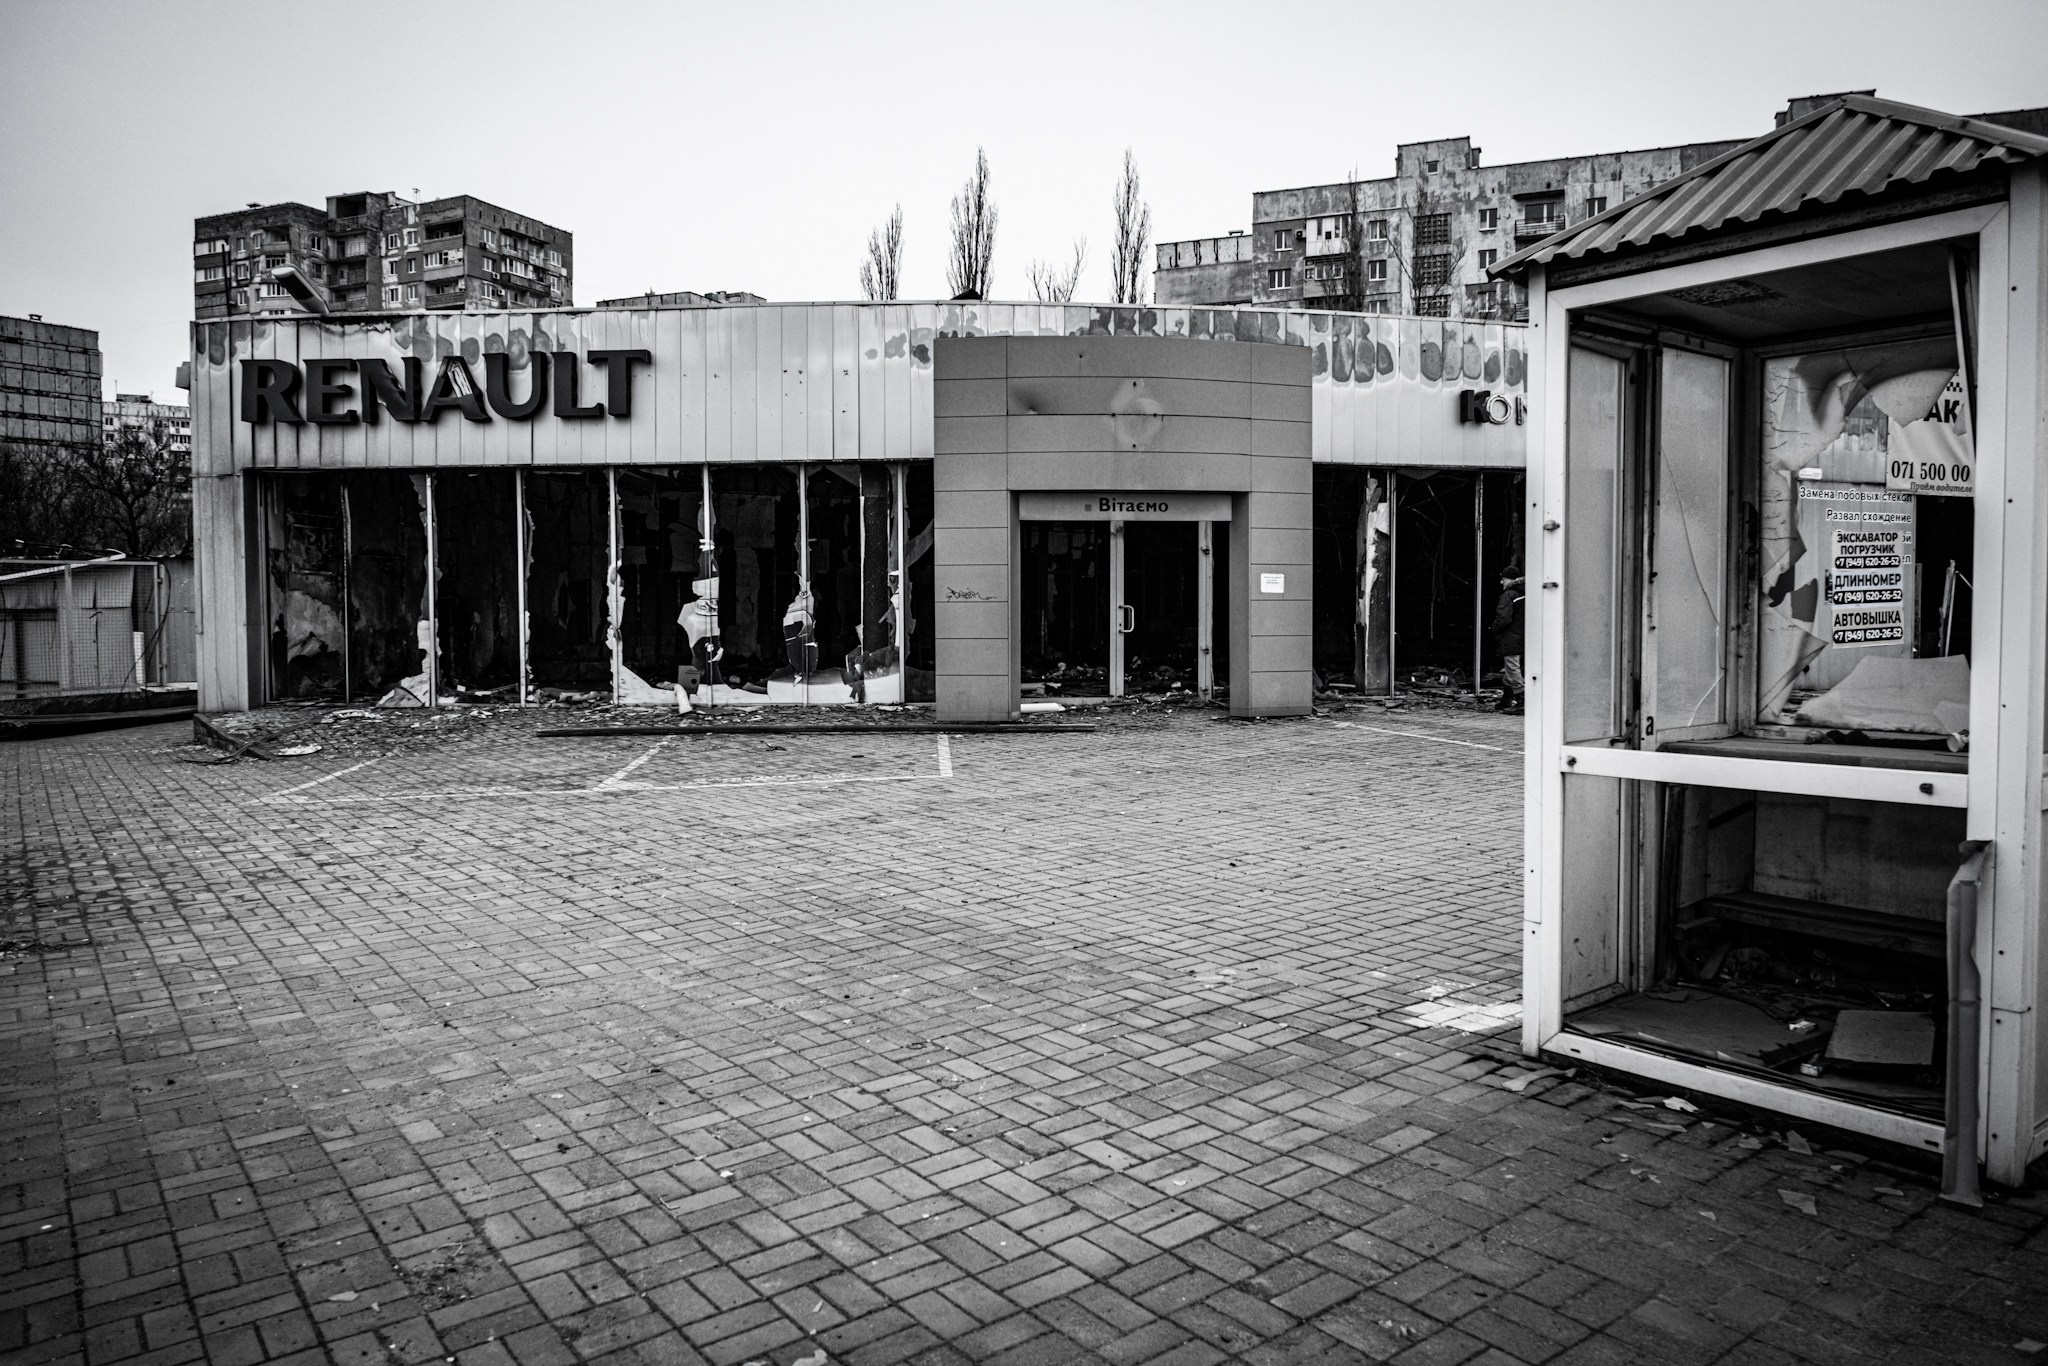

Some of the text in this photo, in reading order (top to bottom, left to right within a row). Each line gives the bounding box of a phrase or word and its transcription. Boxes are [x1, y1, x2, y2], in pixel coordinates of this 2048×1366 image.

[239, 349, 651, 424] RENAULT
[1891, 460, 1914, 479] 071
[1920, 462, 1946, 481] 500
[1800, 486, 1835, 499] Замена
[1837, 489, 1879, 501] лобовых
[1910, 481, 1935, 493] Приём
[1099, 497, 1169, 512] Вітаємо
[1826, 509, 1912, 525] Развал схождение
[1837, 532, 1899, 543] ЭКСКАВАТОР
[1840, 544, 1895, 555] ПОГРУЗЧИК
[1835, 558, 1844, 567] +7
[1845, 557, 1864, 569] (949)
[1865, 556, 1900, 567] 620-26-52
[1835, 573, 1902, 589] ДЛИННОМЕР
[1833, 590, 1902, 603] +7 (949) 620-26-52
[1834, 610, 1902, 627] АВТОВЫШКА
[1834, 628, 1902, 642] +7 (949) 620-26-52
